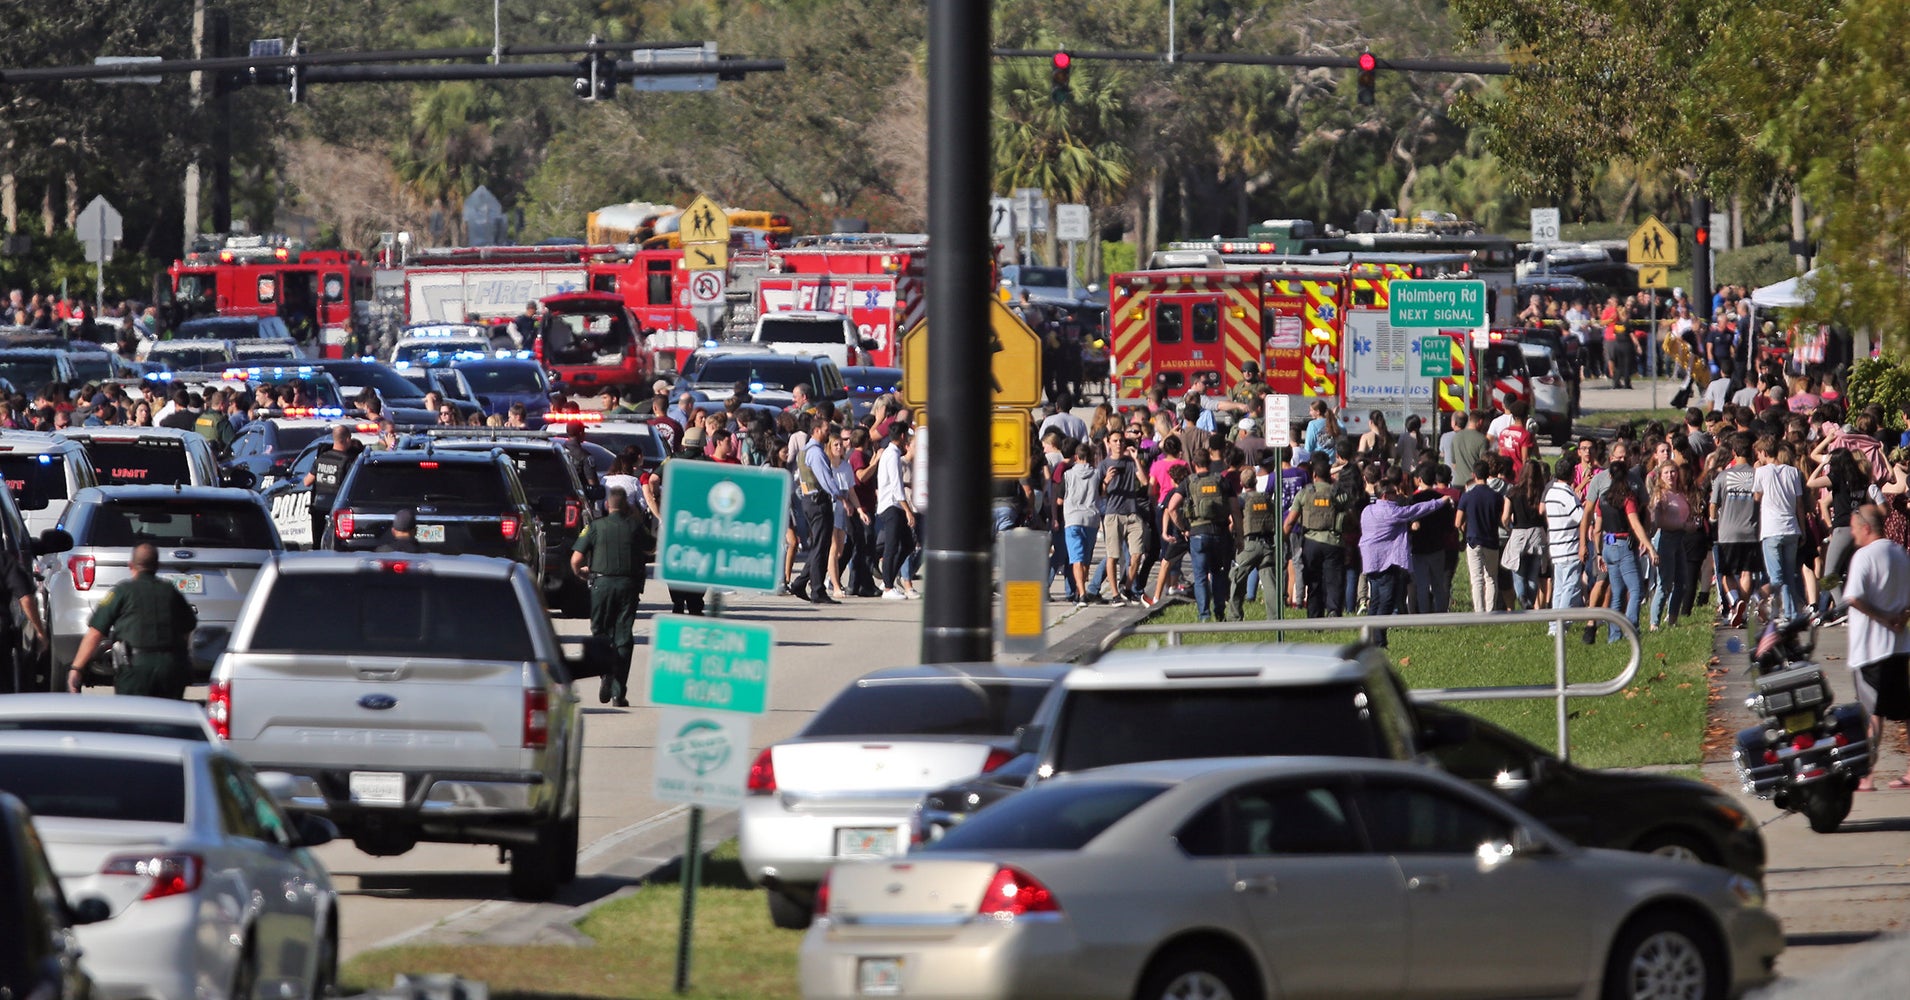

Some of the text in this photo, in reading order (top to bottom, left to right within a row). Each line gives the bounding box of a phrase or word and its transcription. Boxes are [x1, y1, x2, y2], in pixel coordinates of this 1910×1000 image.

[1535, 226, 1556, 238] 40
[474, 280, 532, 305] FIRE
[798, 285, 848, 311] FIRE
[1397, 288, 1477, 306] Holmberg Rd
[1399, 309, 1475, 321] NEXT SIGNAL
[1424, 339, 1447, 349] CITY
[1311, 344, 1330, 363] 44
[1423, 352, 1449, 361] HALL
[1160, 359, 1215, 368] LAUDERHILL
[1265, 369, 1299, 377] ESCUE
[112, 468, 148, 478] UNIT
[317, 463, 338, 474] POLICE
[316, 473, 336, 484] K-9
[1201, 485, 1217, 493] FBI
[271, 491, 312, 521] POLIC
[1314, 498, 1330, 507] FBI
[674, 510, 773, 545] Parkland
[666, 543, 773, 579] City Limit
[679, 626, 747, 653] BEGIN
[653, 651, 766, 681] PINE ISLAND
[683, 679, 734, 705] ROAD
